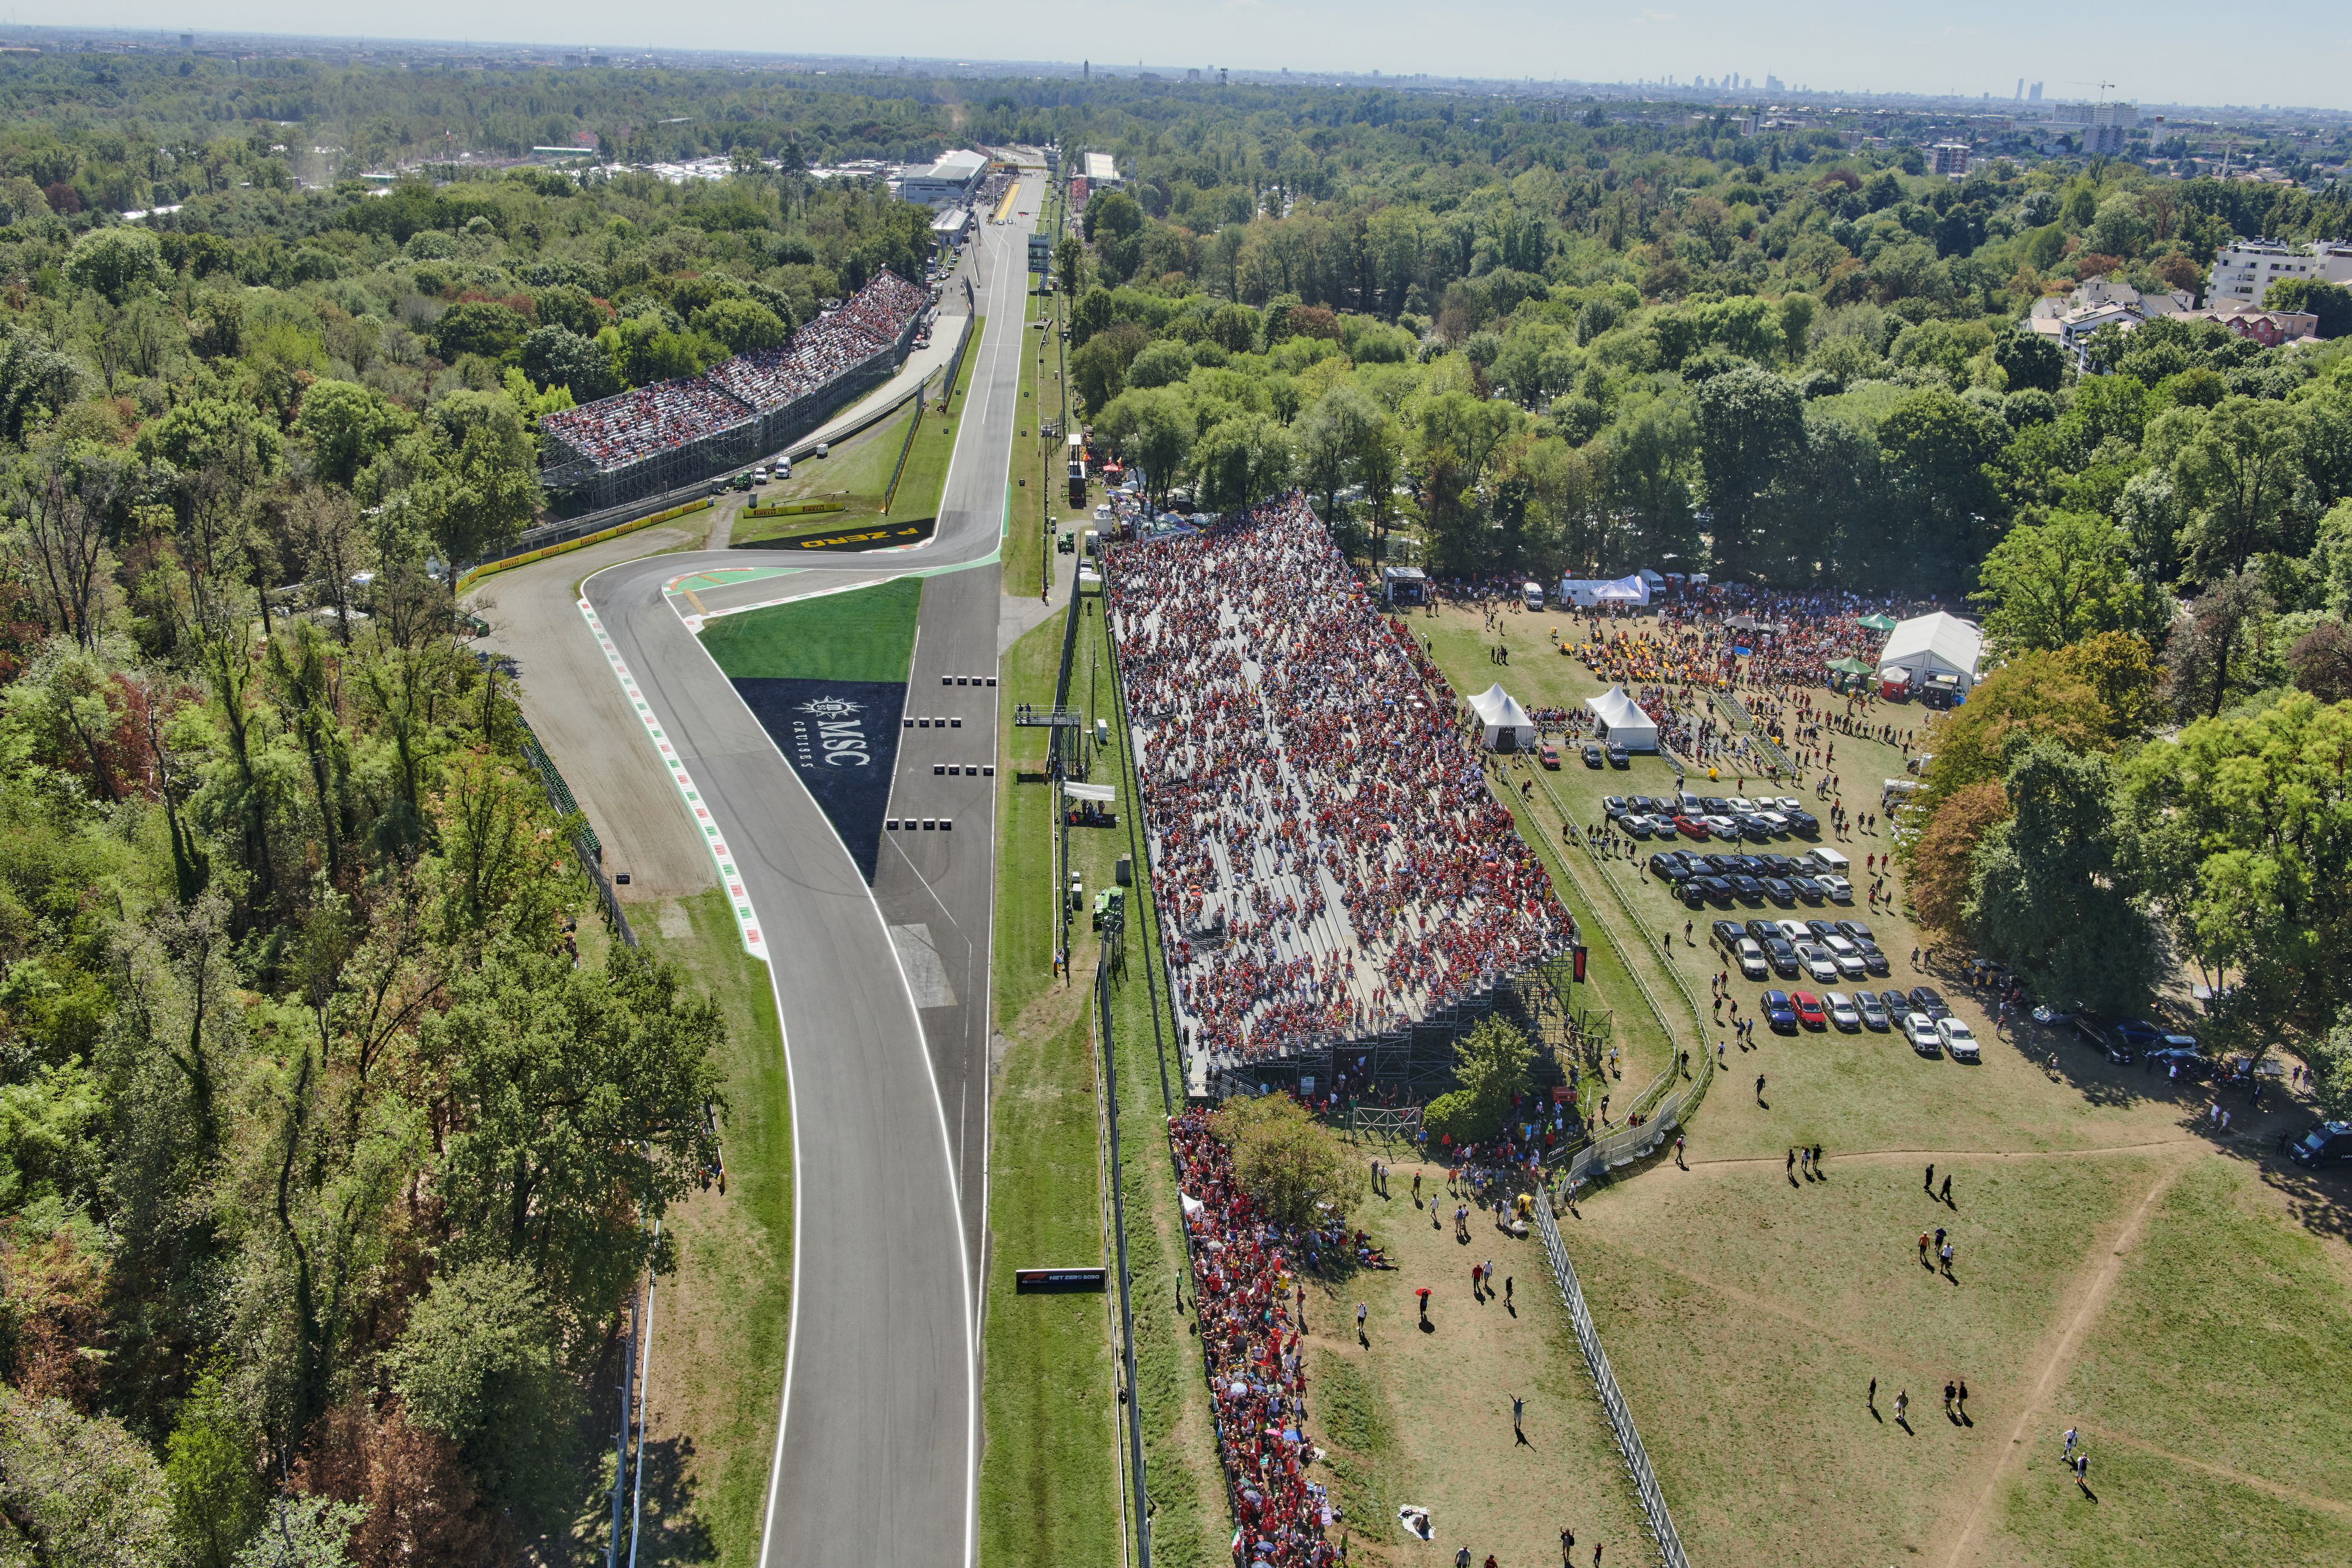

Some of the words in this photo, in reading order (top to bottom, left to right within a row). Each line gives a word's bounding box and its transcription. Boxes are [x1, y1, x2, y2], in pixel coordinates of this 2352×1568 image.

[683, 504, 696, 513] PIRELLI
[651, 514, 666, 523] PIRELLI
[617, 524, 632, 534] PIRELLI
[580, 535, 597, 545] PIRELLI
[800, 531, 891, 547] ZERO
[541, 547, 559, 557] PIRELLI
[500, 558, 519, 569] PIRELLI
[793, 721, 813, 767] CRUISES
[817, 720, 870, 765] MSC
